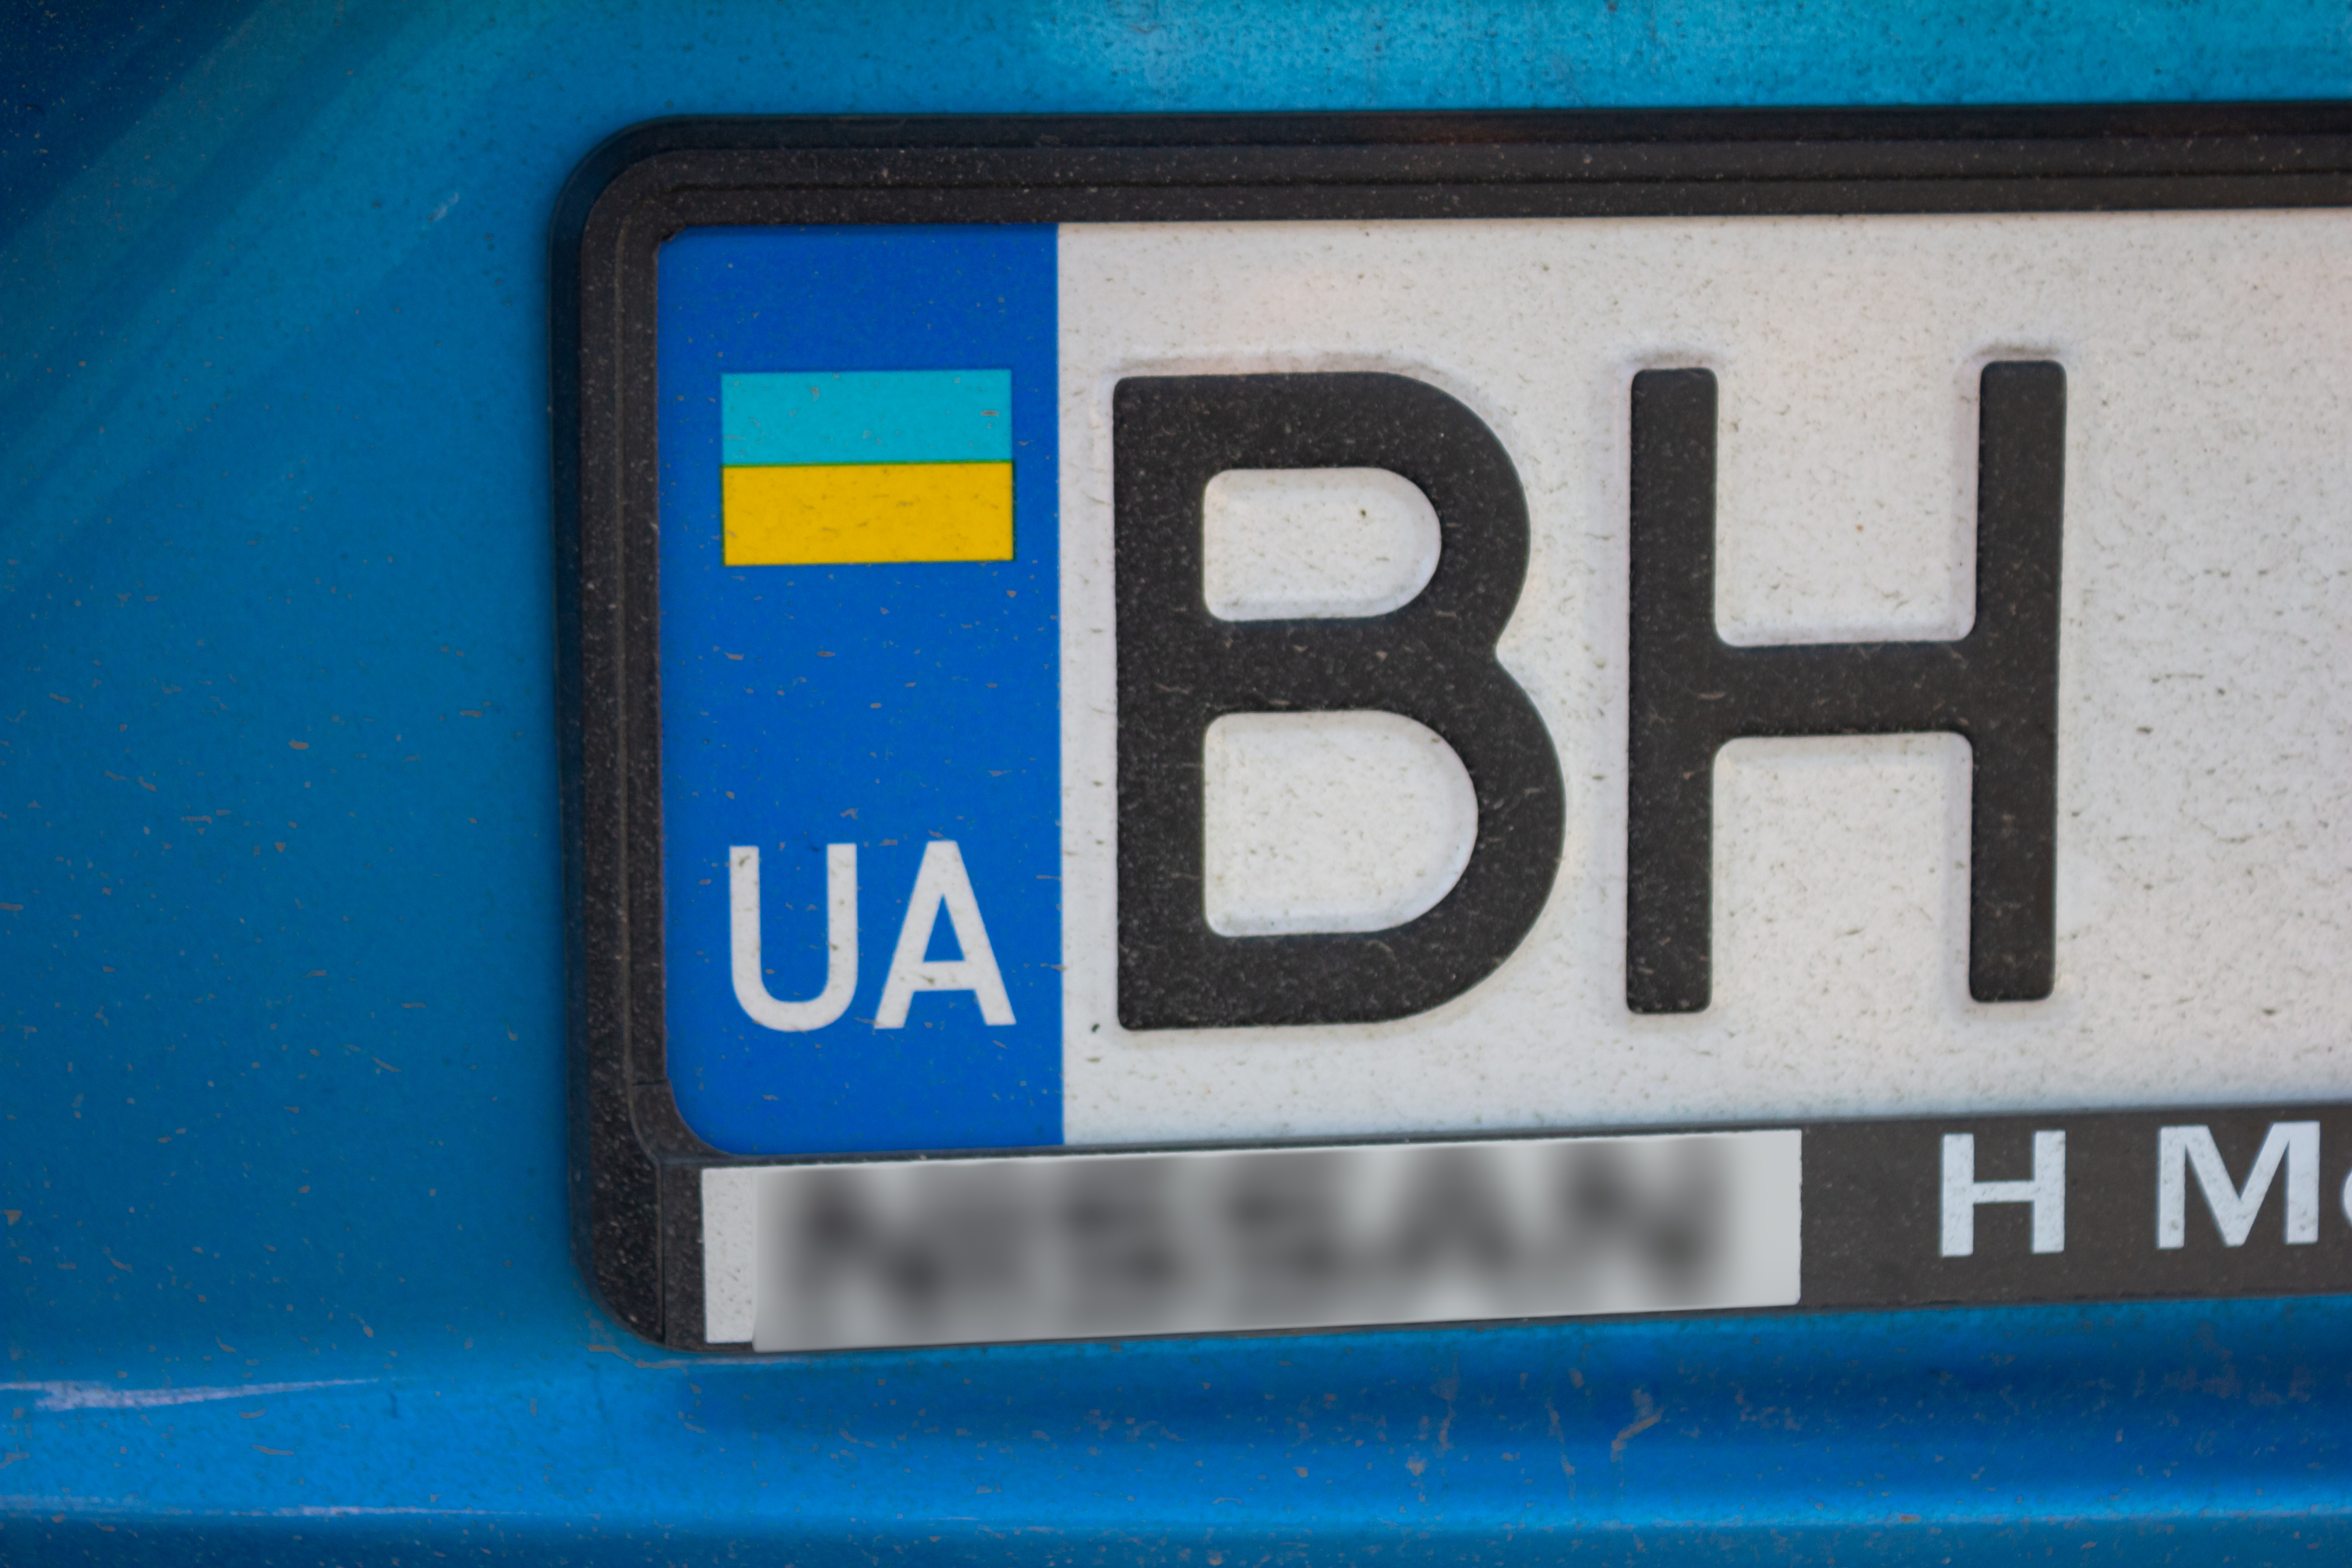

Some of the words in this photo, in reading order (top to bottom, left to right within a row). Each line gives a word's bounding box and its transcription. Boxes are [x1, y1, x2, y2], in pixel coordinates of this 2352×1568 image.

[1113, 359, 2067, 1030] BH
[729, 840, 1017, 1033] UA
[1940, 1129, 2066, 1258] H
[2156, 1119, 2352, 1250] M
